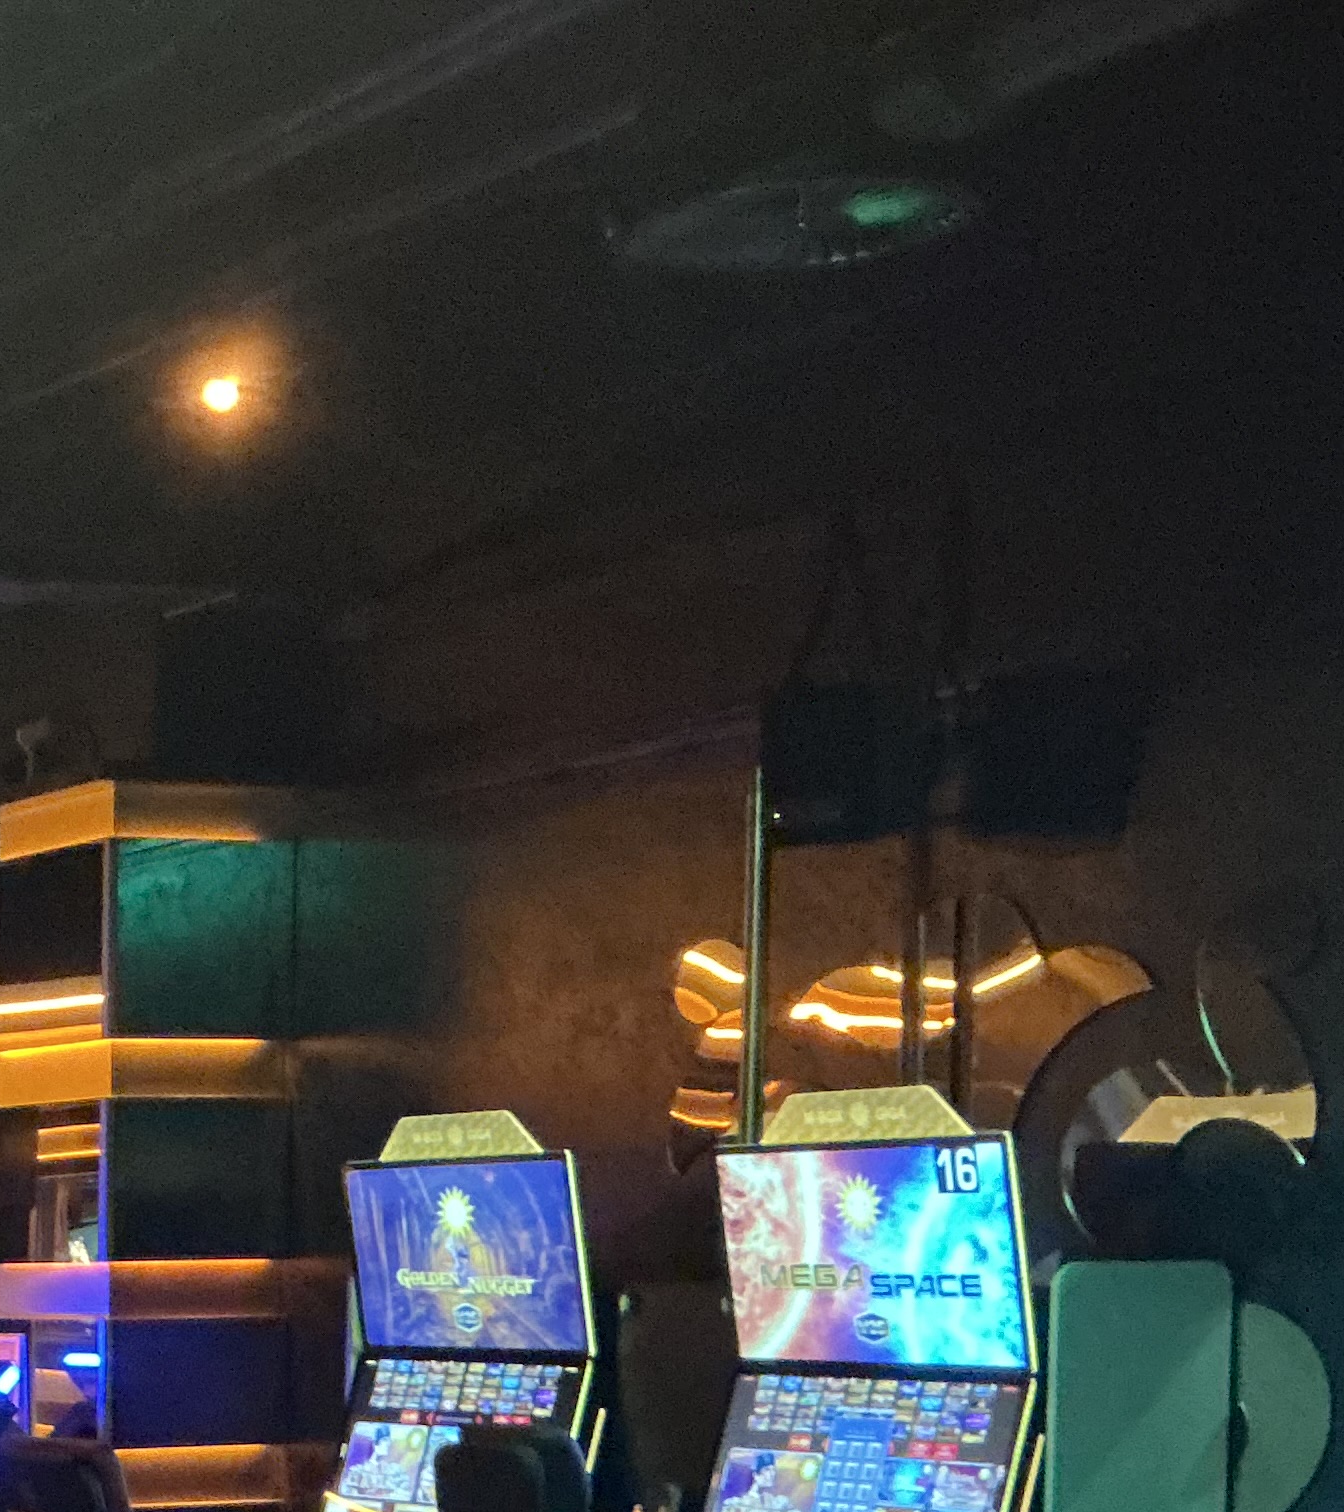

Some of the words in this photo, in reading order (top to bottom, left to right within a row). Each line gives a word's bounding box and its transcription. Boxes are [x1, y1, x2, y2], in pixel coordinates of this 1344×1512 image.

[937, 1149, 978, 1192] 16
[396, 1268, 459, 1289] GOLDEN
[468, 1276, 535, 1297] NUGGET
[761, 1264, 863, 1288] MEGA
[870, 1274, 982, 1298] SPACE
